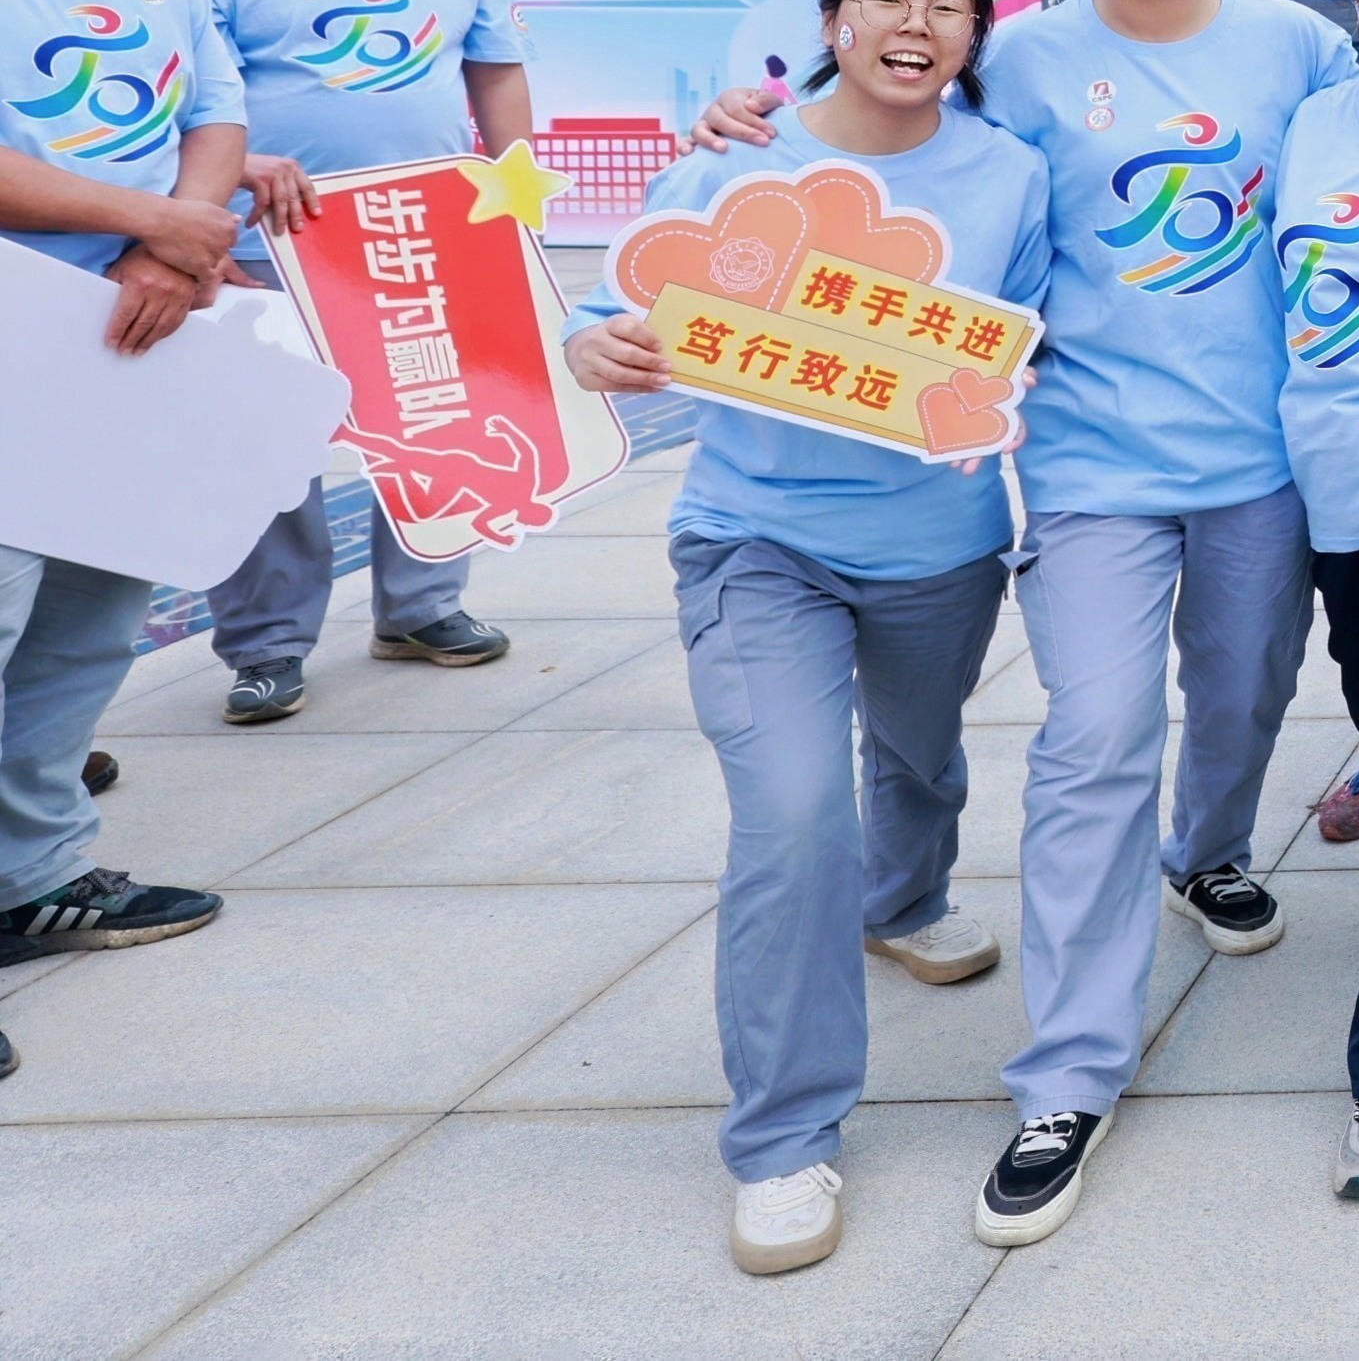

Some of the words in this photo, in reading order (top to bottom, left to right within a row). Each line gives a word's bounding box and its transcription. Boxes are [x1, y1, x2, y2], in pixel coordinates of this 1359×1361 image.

[1092, 93, 1113, 103] CSPC
[353, 188, 471, 439] 步步为赢队
[800, 266, 1006, 362] 携手共进
[676, 316, 899, 412] 笃行致远
